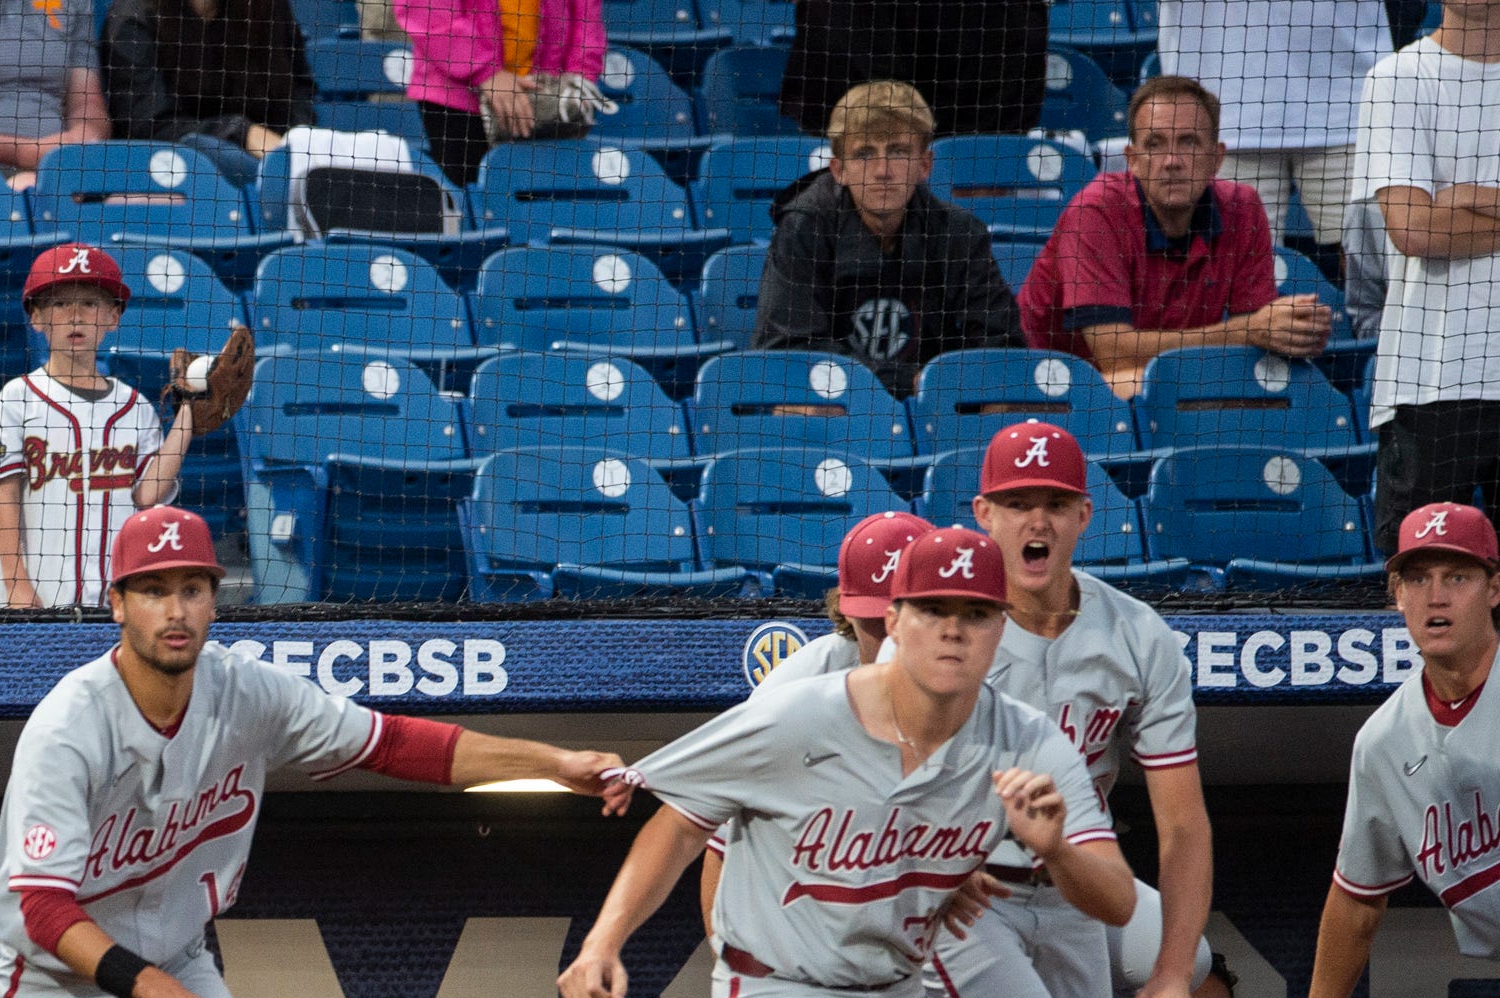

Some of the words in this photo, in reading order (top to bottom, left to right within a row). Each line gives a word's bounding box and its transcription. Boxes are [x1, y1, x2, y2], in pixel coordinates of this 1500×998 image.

[59, 247, 91, 274] A
[847, 299, 909, 360] SEC
[1013, 436, 1050, 468] A
[147, 522, 183, 553] A
[1414, 511, 1448, 538] A
[871, 548, 900, 583] A
[938, 547, 976, 579] A
[25, 826, 56, 861] SEC
[792, 807, 993, 871] Alabama
[1417, 791, 1500, 881] Alab
